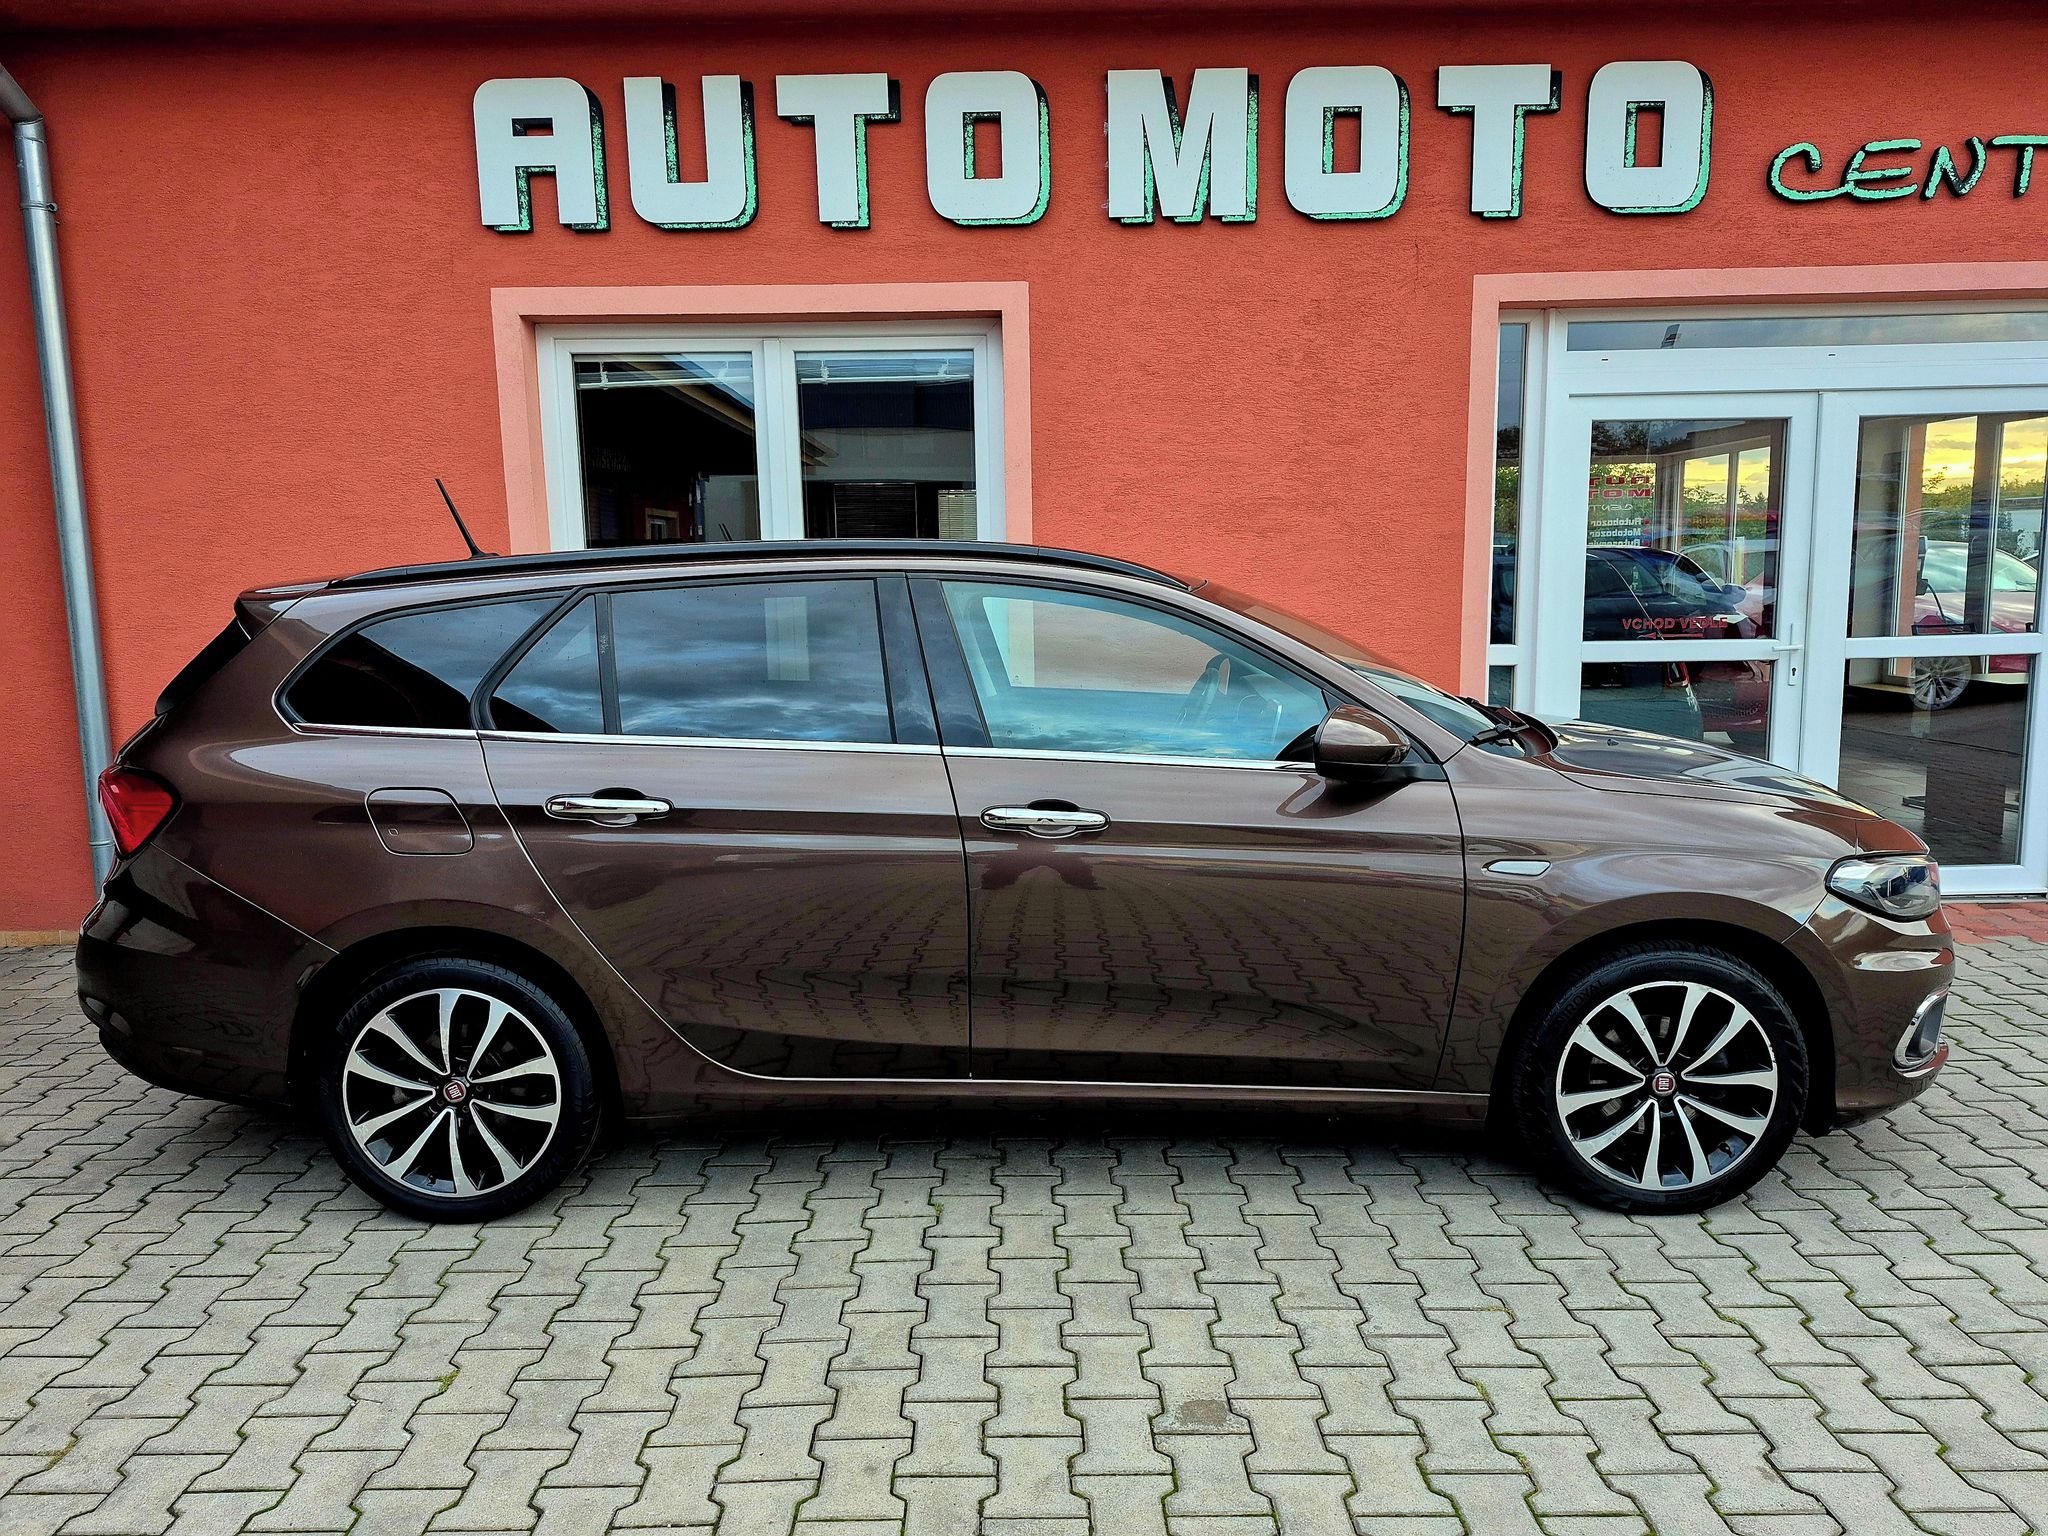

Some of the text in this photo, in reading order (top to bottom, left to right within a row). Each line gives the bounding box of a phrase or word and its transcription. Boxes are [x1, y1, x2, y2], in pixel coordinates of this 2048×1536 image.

[473, 60, 2048, 233] AUTO MOTO CENT
[1622, 617, 1728, 631] VCHOD VEDLE
